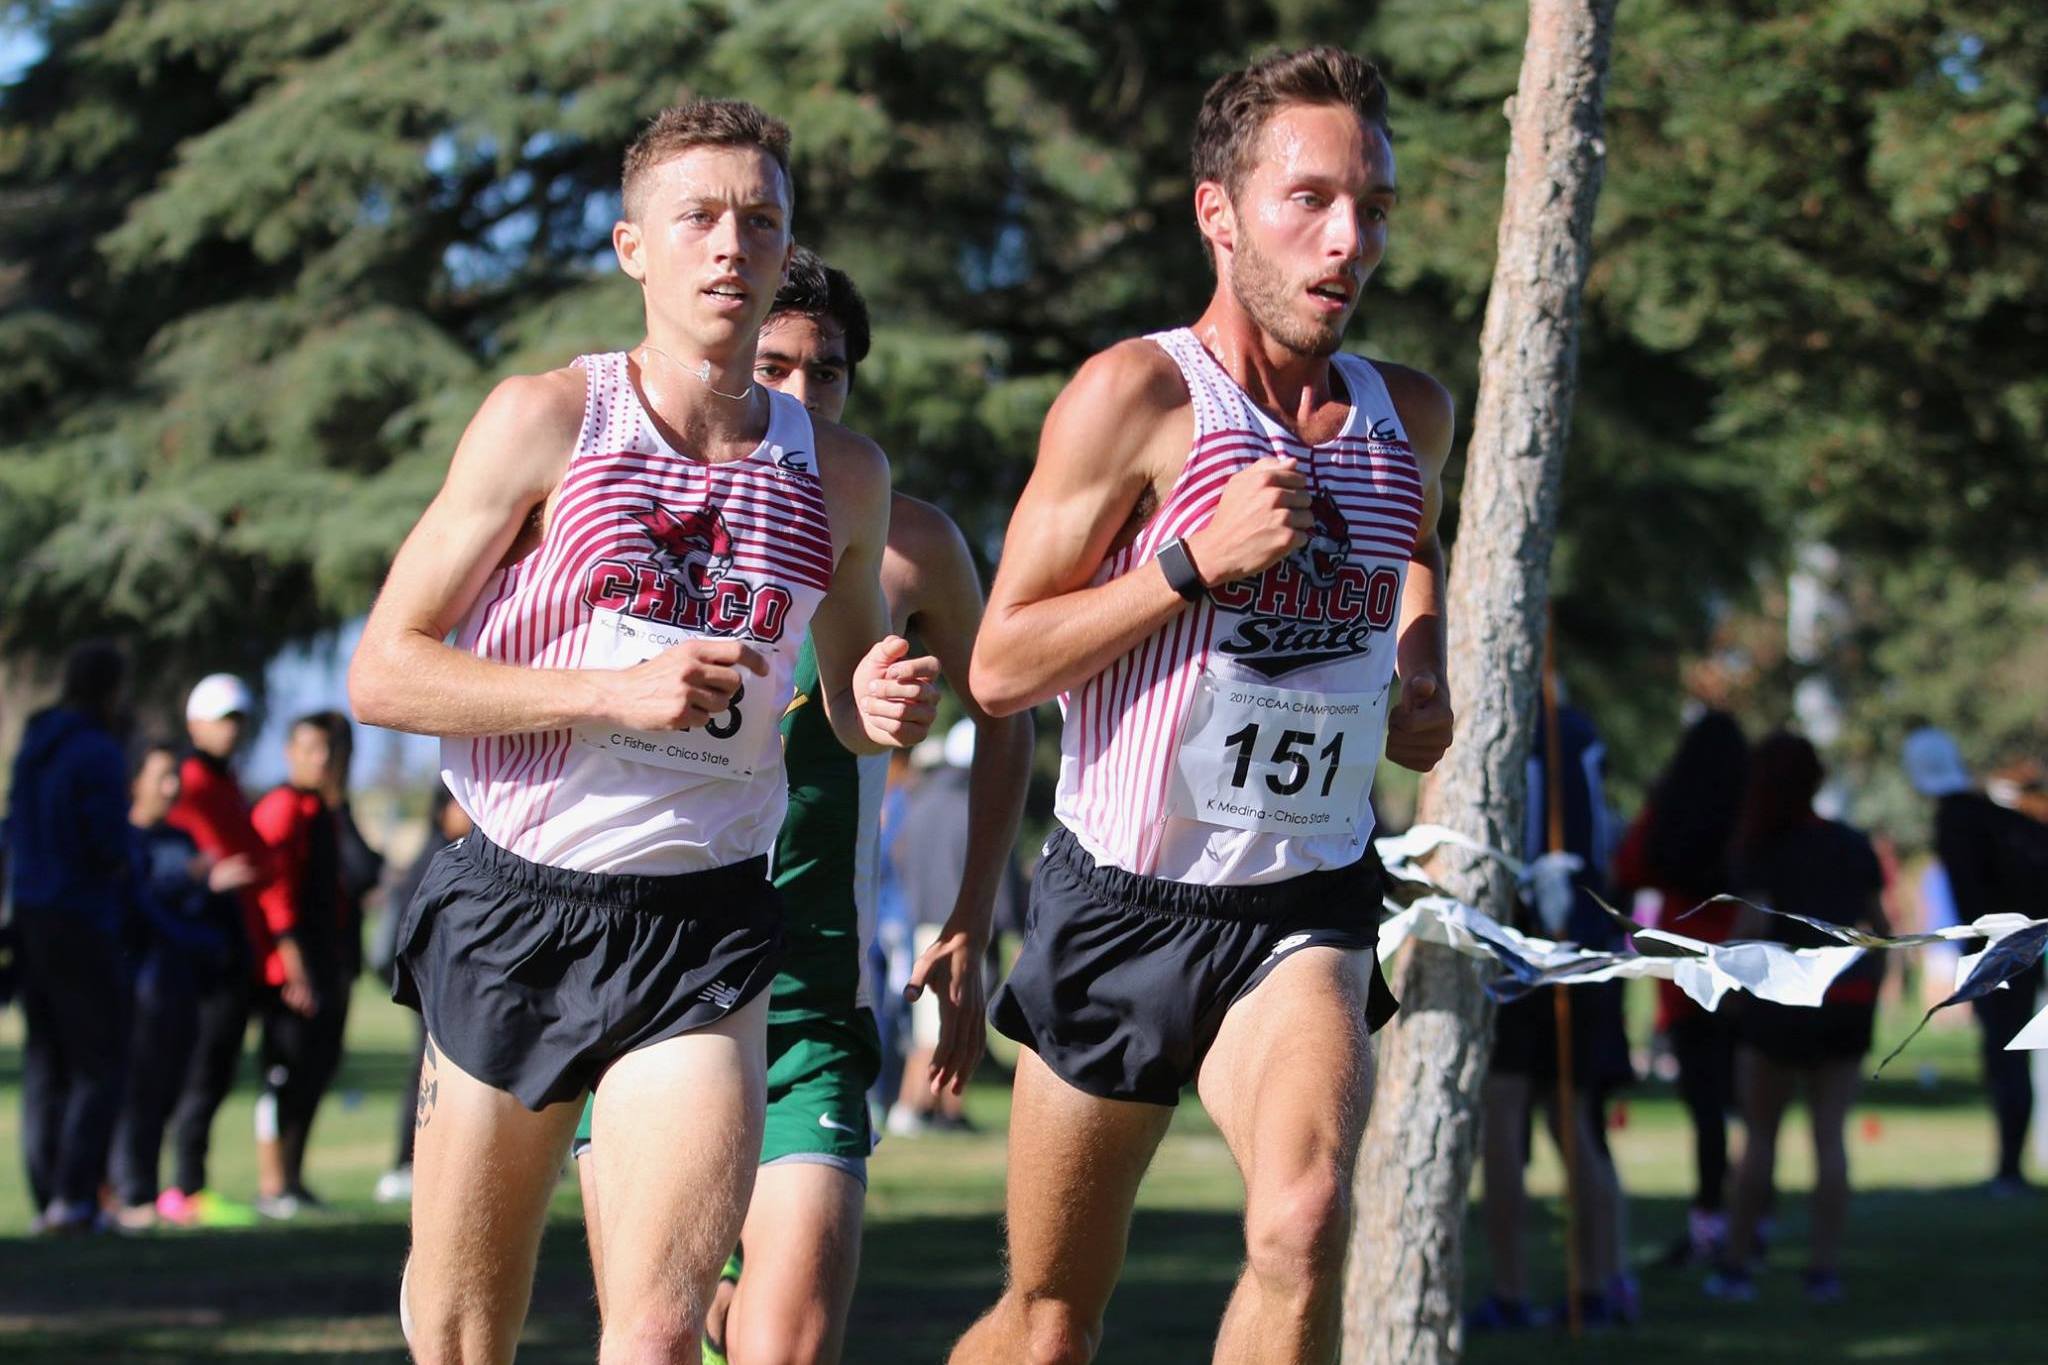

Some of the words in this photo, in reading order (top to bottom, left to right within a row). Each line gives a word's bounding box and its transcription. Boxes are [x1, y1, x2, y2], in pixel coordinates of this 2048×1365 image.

[584, 559, 792, 644] CHICO
[647, 633, 679, 646] CCAA
[1216, 615, 1370, 656] State
[1230, 692, 1255, 703] 2017
[1256, 696, 1289, 711] CCAA
[1292, 702, 1360, 716] CHAMPIONSHIPS
[610, 733, 621, 745] C
[624, 736, 657, 752] Fisher
[666, 745, 699, 761] Chico
[700, 751, 730, 766] State
[1224, 722, 1344, 797] 151
[1206, 799, 1215, 811] K
[1217, 801, 1266, 820] Medina
[1274, 810, 1308, 825] Chico
[1308, 812, 1330, 824] State
